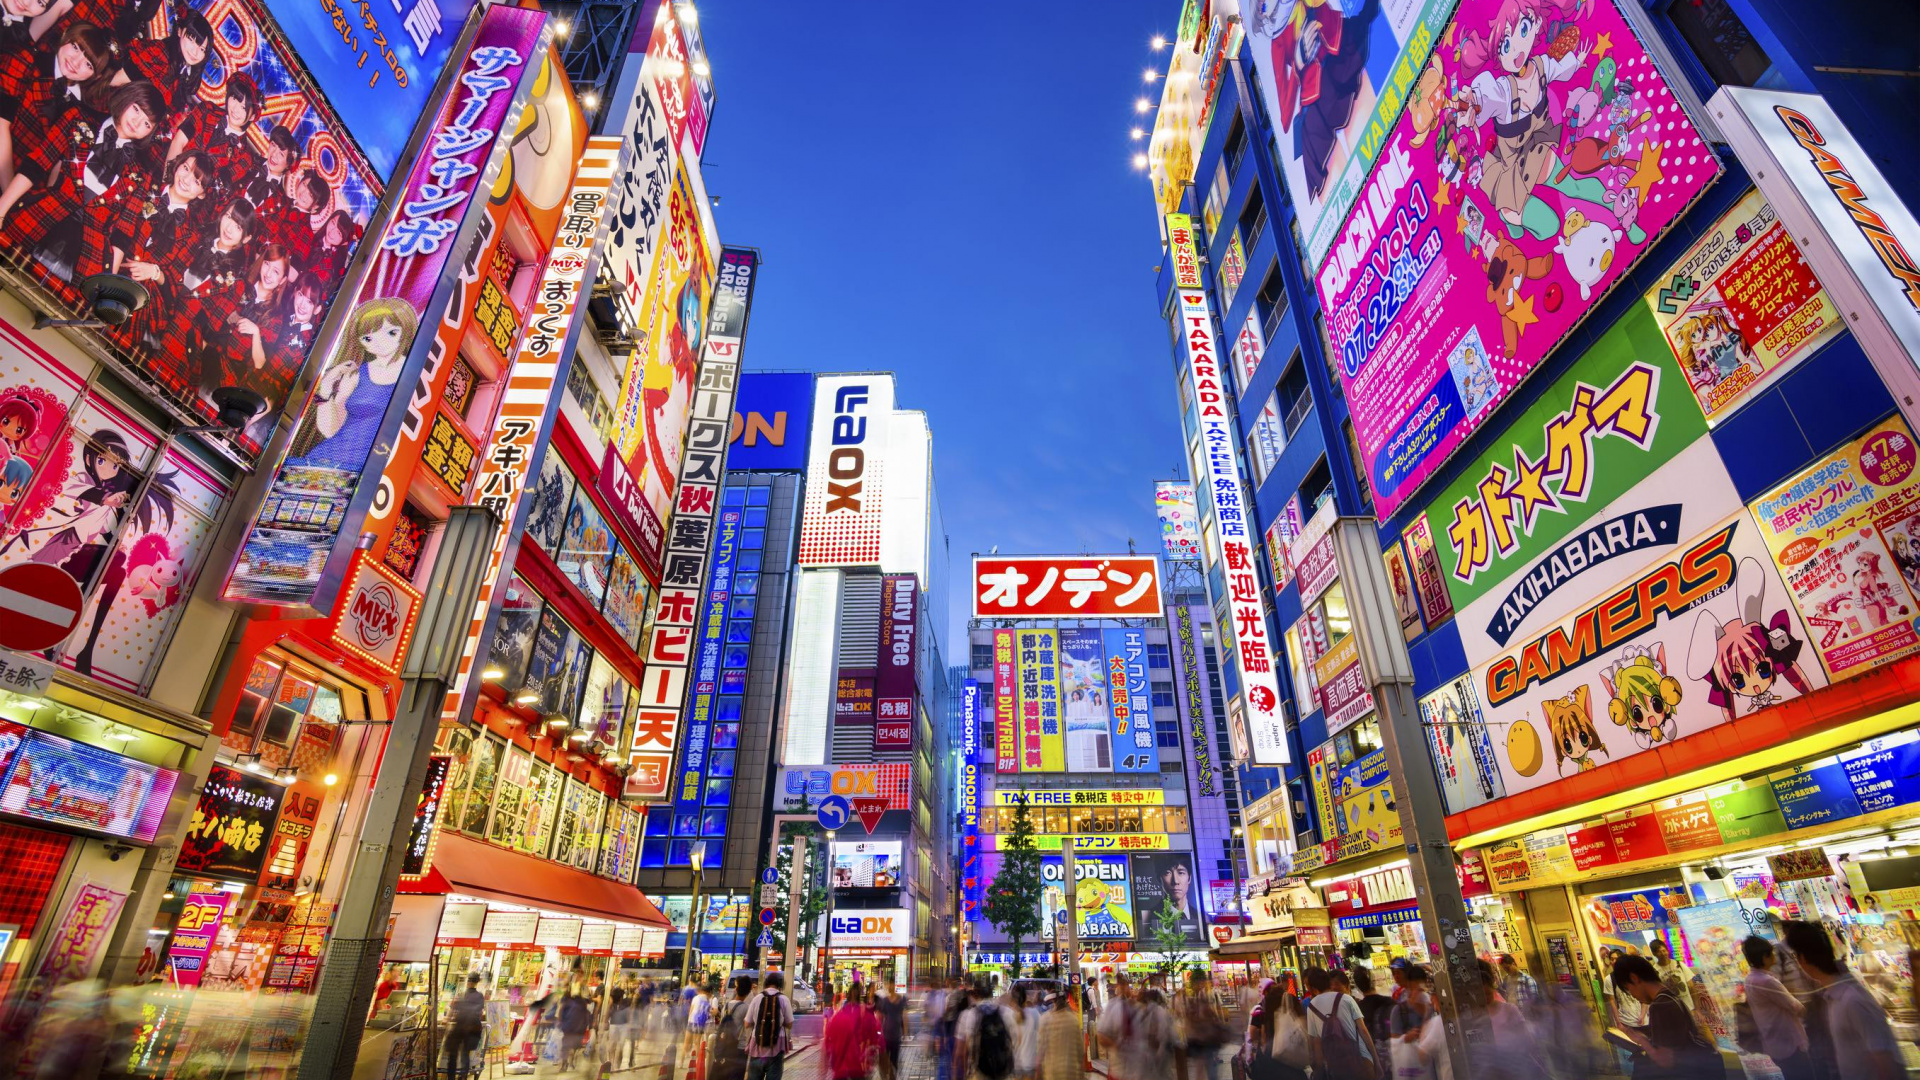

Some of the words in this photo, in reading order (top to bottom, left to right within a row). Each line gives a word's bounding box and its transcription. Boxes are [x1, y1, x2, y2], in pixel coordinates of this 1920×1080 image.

[1361, 123, 1384, 162] VA
[1379, 21, 1431, 129] 購買部
[382, 46, 522, 257] サマージャンボ
[563, 192, 604, 249] 買取り
[1320, 200, 1376, 312] PUNCH
[1368, 132, 1414, 231] LINE
[1172, 227, 1200, 285] まんが喫茶
[1393, 248, 1412, 284] ON
[711, 253, 736, 333] PARADISE
[734, 253, 753, 308] HOBBY
[1738, 254, 1792, 303] なのはViVid
[1749, 268, 1794, 311] オリジナル
[482, 277, 516, 331] 現金
[1755, 278, 1801, 321] ブロマイド
[474, 300, 509, 357] 買取
[530, 279, 577, 358] まっくす
[1338, 308, 1359, 347] DVD
[1343, 277, 1402, 376] 07.22
[1187, 317, 1224, 417] TAKARADA
[1691, 331, 1741, 376] SAMPLE
[431, 411, 474, 472] 高額
[1860, 434, 1907, 469] 第7巻
[422, 438, 468, 496] 査定
[1880, 454, 1901, 472] 好評
[1213, 477, 1245, 536] 免税商店
[1757, 458, 1849, 522] 俺がお嬢様学校に
[724, 513, 738, 521] 6F
[979, 560, 1153, 609] オノデン
[1312, 565, 1336, 596] TAKARADA
[1504, 512, 1656, 631] AKIHABARA
[711, 592, 727, 600] 5F
[883, 579, 894, 617] Flagship
[893, 579, 915, 621] Duty
[1224, 541, 1270, 674] 歓迎光臨
[1688, 583, 1730, 609] ANIBRO
[1855, 584, 1903, 608] SAMPLE
[1487, 520, 1740, 707] GAMERS
[700, 602, 724, 681] 冷蔵庫・洗濯機
[883, 620, 893, 645] Store
[892, 625, 913, 666] Free
[997, 633, 1011, 663] 免税
[697, 683, 713, 692] 4F
[838, 679, 856, 688] 本店
[838, 688, 873, 698] 総合家電
[880, 702, 908, 715] 免税
[965, 686, 976, 755] Panasonic
[1340, 697, 1367, 723] TAKARADA
[878, 728, 909, 739] 면세점
[1256, 730, 1265, 749] Shop
[1272, 722, 1280, 749] Japan.
[1870, 740, 1883, 752] 6F
[508, 752, 530, 785] 1F
[998, 758, 1016, 770] B1F
[1122, 754, 1150, 769] 4F
[1310, 750, 1321, 765] 2F
[284, 792, 320, 821] 入口
[567, 784, 582, 812] 2F
[859, 805, 882, 813] 止まれ
[966, 765, 976, 825] ONODEN
[1002, 793, 1030, 804] TAX
[1034, 792, 1071, 804] FREE
[1075, 792, 1107, 804] 免税店
[1316, 784, 1329, 839] COMPUTER
[1715, 800, 1726, 809] CD
[278, 818, 313, 839] はコチラ
[1720, 813, 1735, 823] DVD
[1075, 837, 1115, 848] エアコン
[1347, 841, 1371, 856] MOBILES
[1490, 848, 1523, 864] GAMERS
[1108, 885, 1126, 904] 迎
[1135, 876, 1152, 884] 教えて
[178, 903, 221, 930] 2F
[1044, 923, 1130, 936] AABARA
[1505, 908, 1523, 950] TAX
